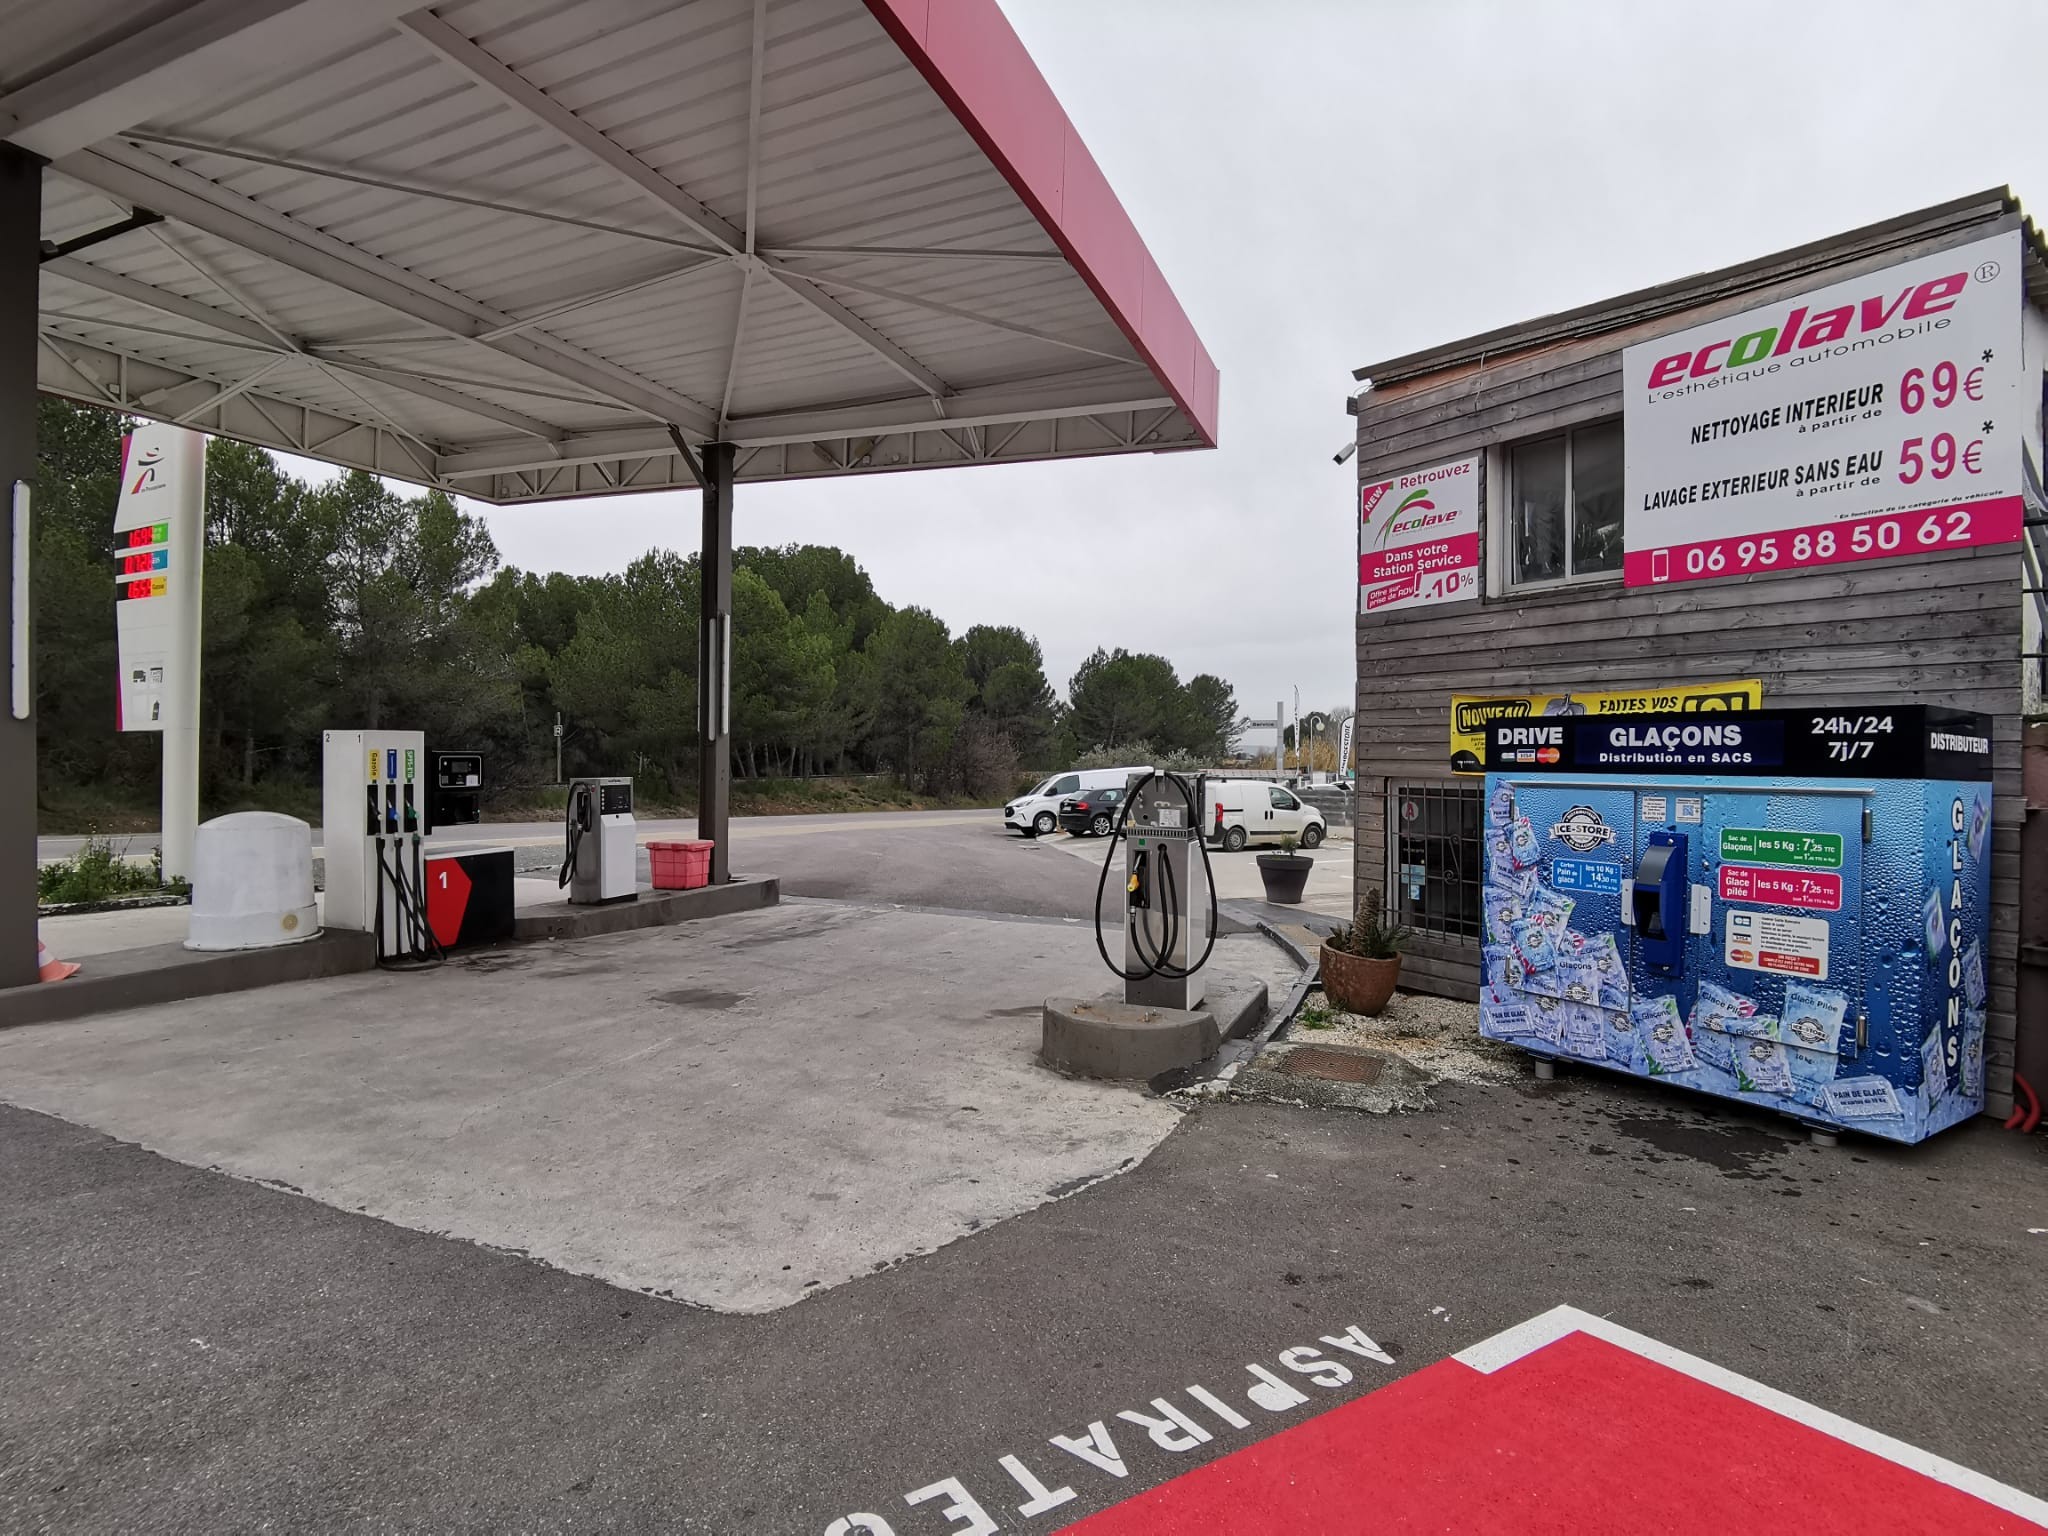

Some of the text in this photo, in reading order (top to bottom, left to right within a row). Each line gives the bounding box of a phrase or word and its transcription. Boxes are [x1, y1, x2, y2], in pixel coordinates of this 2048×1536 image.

[1648, 271, 1968, 390] ecolave
[1648, 318, 1951, 404] L'esthétique automobile
[1691, 383, 1884, 445] NETTOYAGE INTERIEUR
[1798, 407, 1883, 434] à partir de
[1400, 463, 1470, 489] Retrouvez
[1644, 450, 1884, 512] LAVAGE EXTERIEUR SANS EAU
[1796, 474, 1881, 499] à partir de
[1364, 486, 1384, 512] NEW
[1392, 510, 1458, 533] ecolave
[1686, 511, 1972, 574] 06 95 88 50 62
[1386, 543, 1449, 564] Dans votre
[1373, 553, 1462, 578] Station Service
[1599, 698, 1647, 713] FAITES
[1652, 696, 1679, 710] VOS
[1811, 716, 1894, 735] 24h/24
[325, 733, 330, 743] 2
[357, 733, 361, 744] 1
[1498, 726, 1563, 745] DRIVE
[1608, 725, 1743, 751] GLAÇONS
[1930, 732, 1989, 755] DISTRIBUTEUR
[1600, 751, 1752, 763] Distribution en SACS
[1828, 741, 1875, 762] 7j/7
[1405, 801, 1416, 817] A
[1556, 824, 1609, 837] ICE-STORE
[1722, 842, 1753, 852] Glaçons
[1758, 839, 1772, 849] les
[1774, 840, 1780, 849] 5
[1782, 841, 1795, 852] Kg
[439, 871, 448, 889] 1
[1558, 876, 1575, 884] glace
[1605, 867, 1614, 875] Kg
[1727, 869, 1739, 877] Sac
[1725, 876, 1750, 887] Glace
[1757, 880, 1771, 889] les
[1772, 881, 1779, 890] 5
[1781, 881, 1794, 893] Kg
[1726, 887, 1748, 897] pilée
[1560, 961, 1592, 970] Glaçons
[1701, 991, 1726, 1008] Glace
[1790, 993, 1839, 1012] Glace Pilée
[1735, 1028, 1769, 1037] Glaçons
[1852, 1090, 1862, 1098] DE
[1862, 1088, 1887, 1097] GLACE
